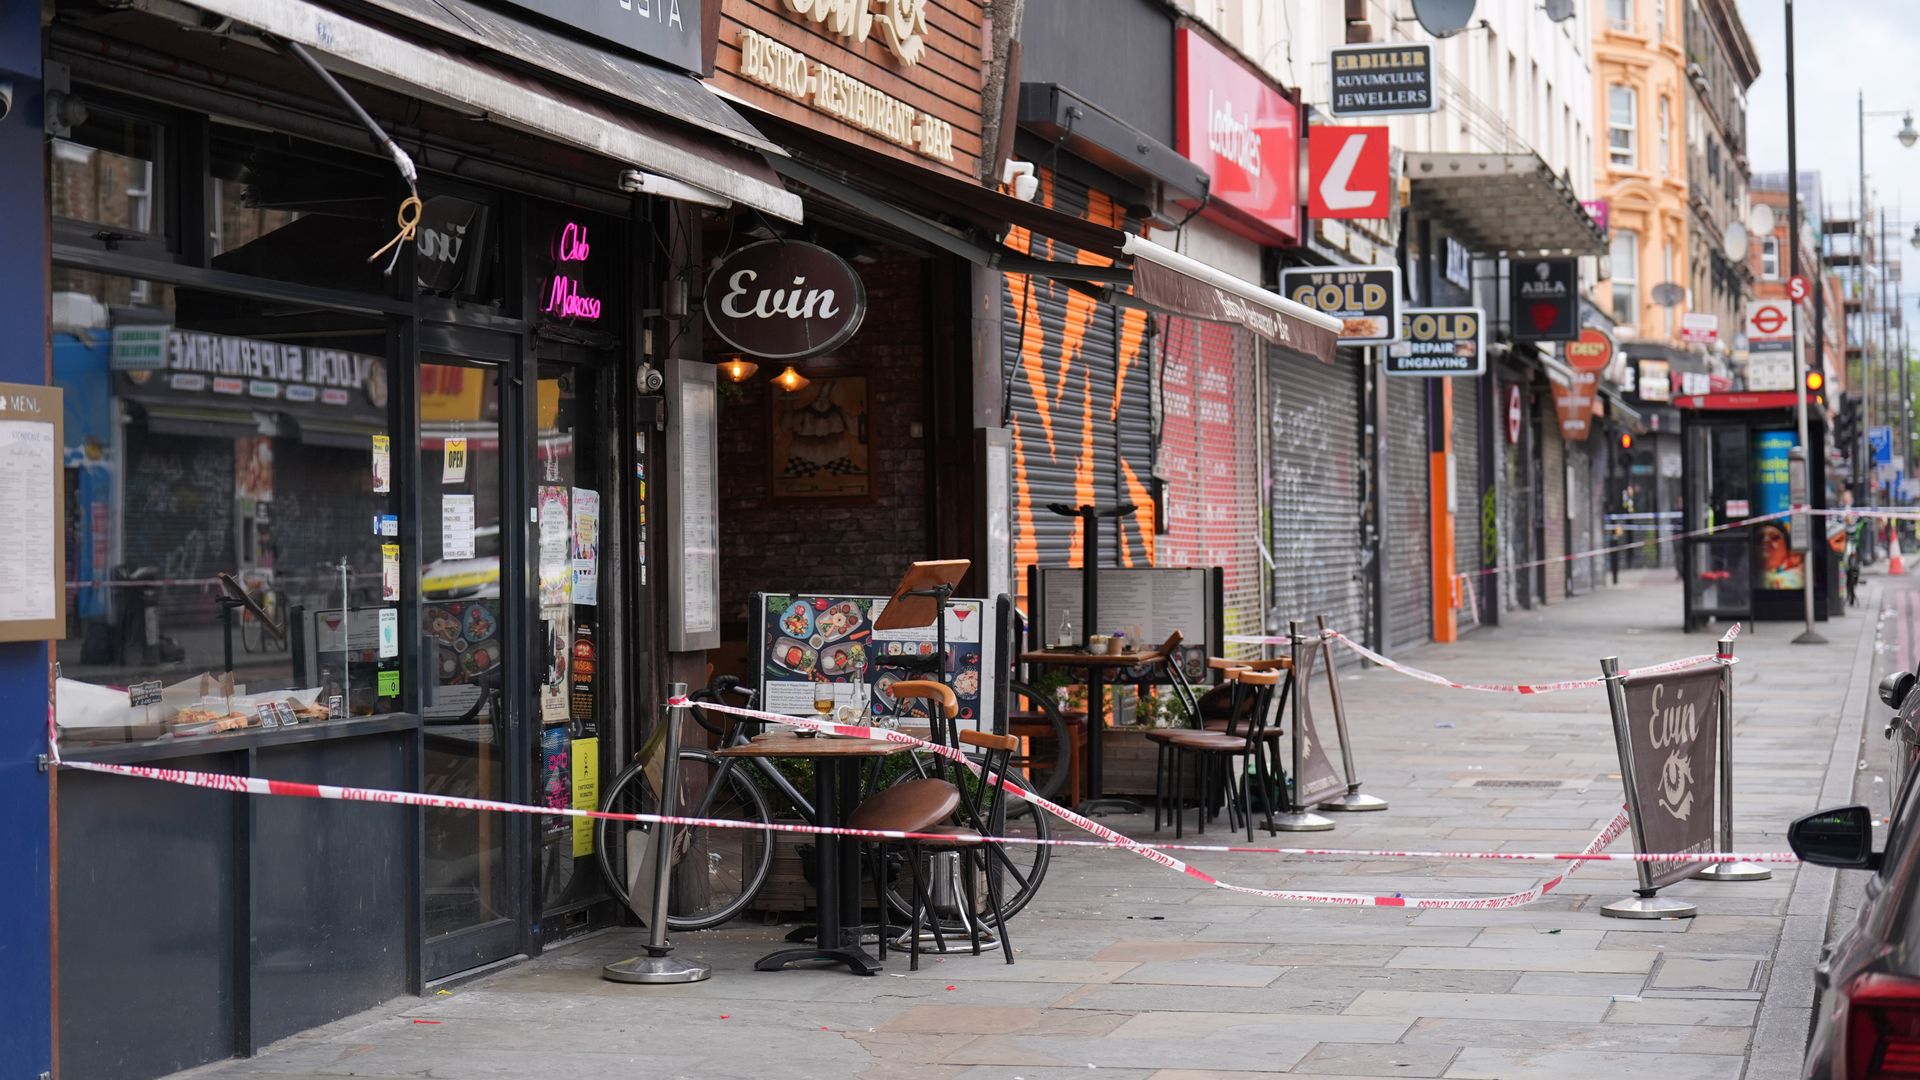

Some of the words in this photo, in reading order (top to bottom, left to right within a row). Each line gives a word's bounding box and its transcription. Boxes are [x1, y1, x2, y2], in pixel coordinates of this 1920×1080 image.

[1336, 51, 1426, 70] ERBILLER
[1336, 72, 1425, 88] KUYUMCULUK
[742, 28, 808, 98] BISTRO
[814, 63, 914, 146] RESTAURANT
[919, 113, 954, 161] BAR
[1337, 90, 1427, 107] JEWELLERS
[1208, 88, 1262, 177] Ladbrokes
[560, 222, 590, 261] Club
[1311, 274, 1332, 285] WE
[1338, 273, 1367, 284] BUY
[545, 275, 601, 320] Makossa
[720, 269, 840, 319] Evin
[1293, 283, 1387, 312] GOLD
[1412, 341, 1454, 354] REPAIR
[1397, 357, 1468, 369] ENGRAVING
[449, 450, 464, 469] OPEN
[1649, 683, 1699, 750] Evin
[194, 773, 249, 793] CROSS
